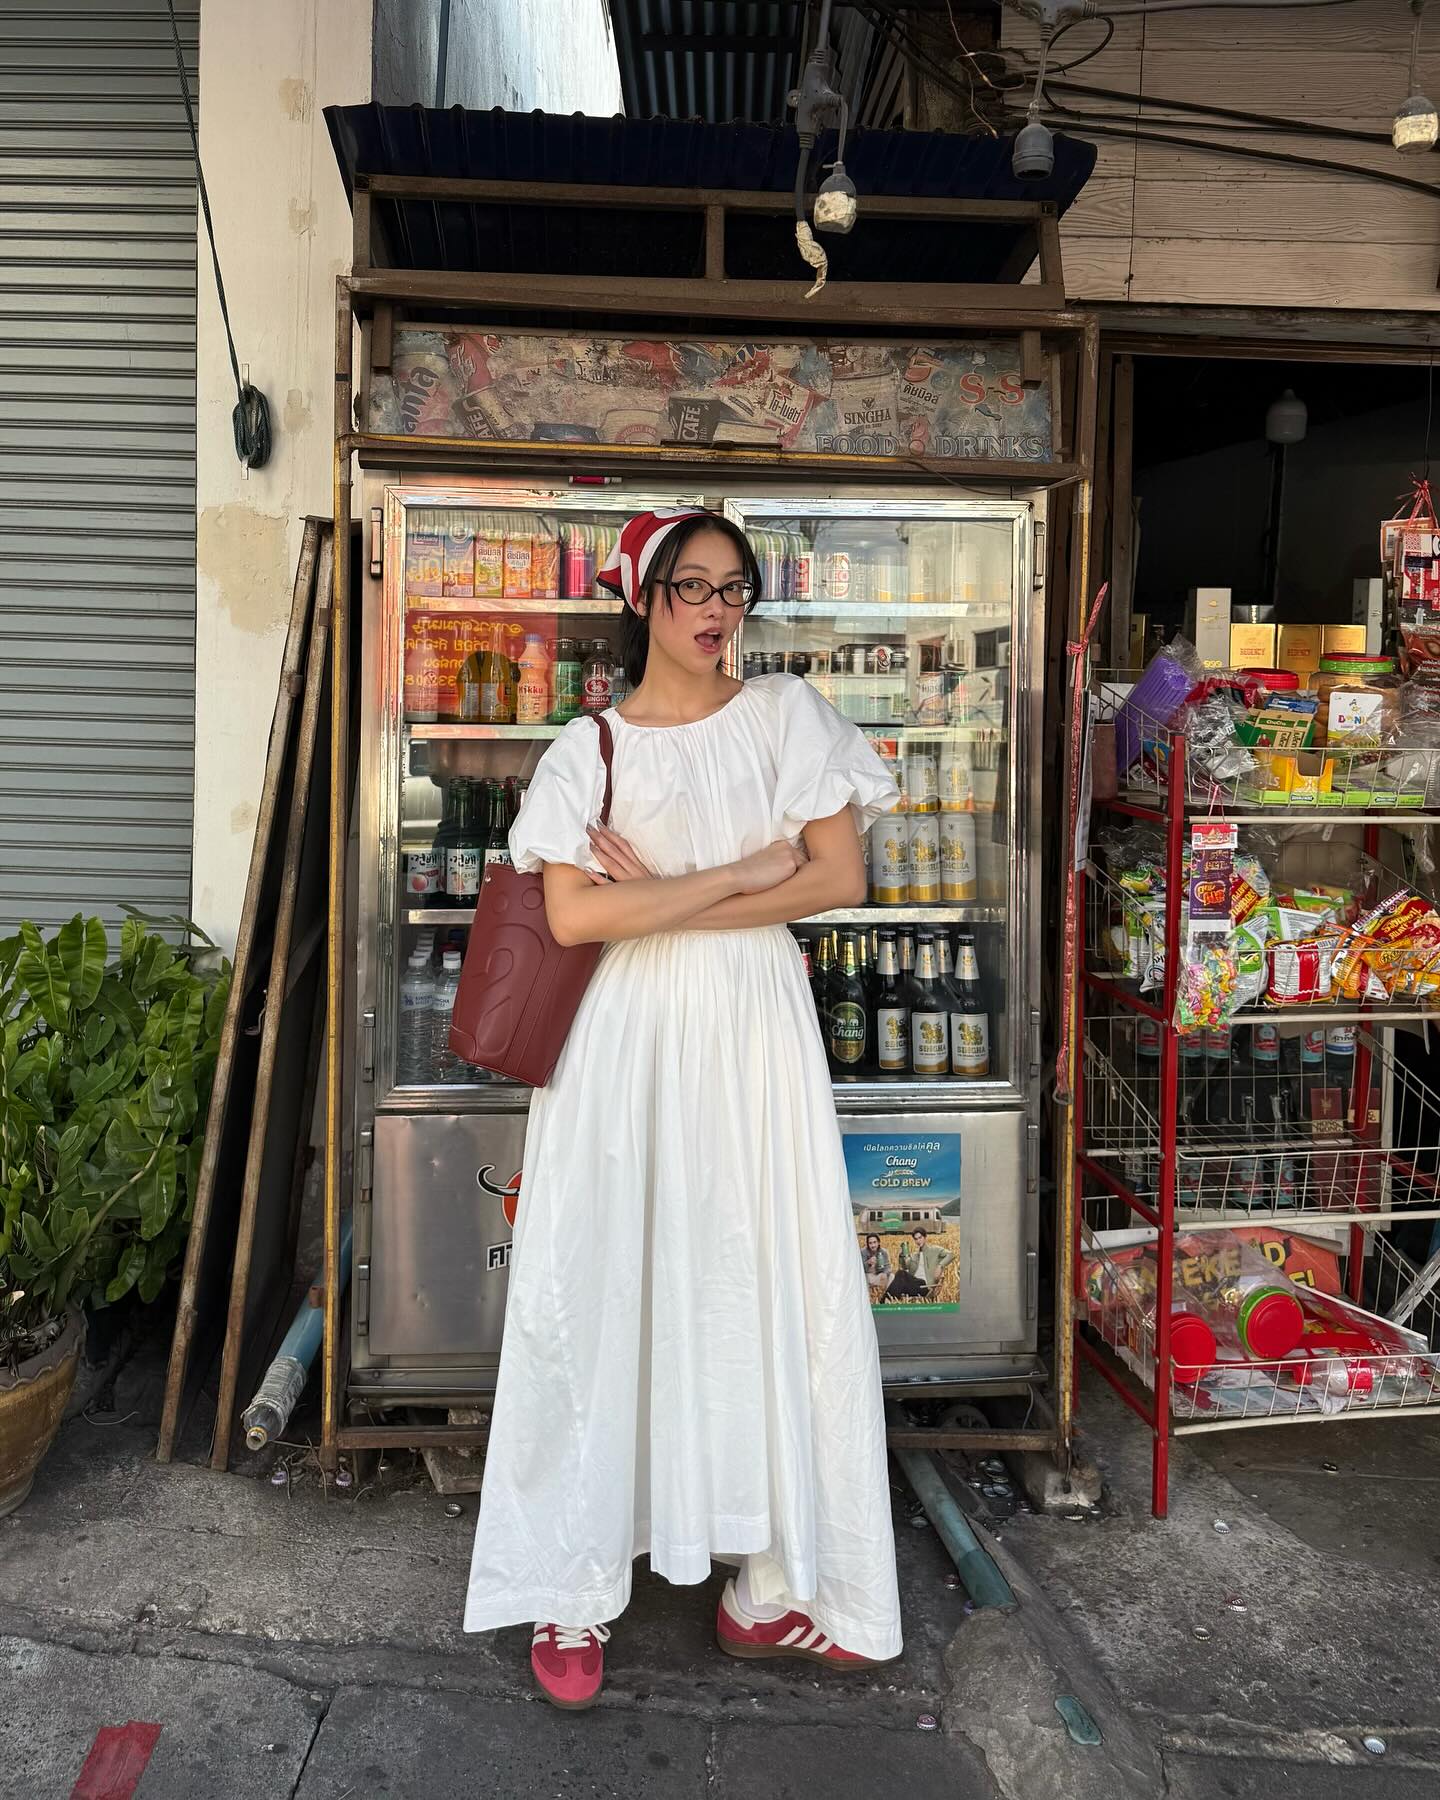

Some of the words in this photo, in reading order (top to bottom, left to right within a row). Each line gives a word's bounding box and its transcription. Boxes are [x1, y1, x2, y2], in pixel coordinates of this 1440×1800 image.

[403, 366, 439, 433] anta
[843, 407, 892, 425] SINGHA
[815, 434, 900, 457] FOOD
[935, 435, 1046, 459] DRINKS
[832, 1024, 864, 1040] Chang
[885, 1155, 917, 1168] Chang
[872, 1178, 900, 1188] COLD
[902, 1178, 931, 1188] BREW
